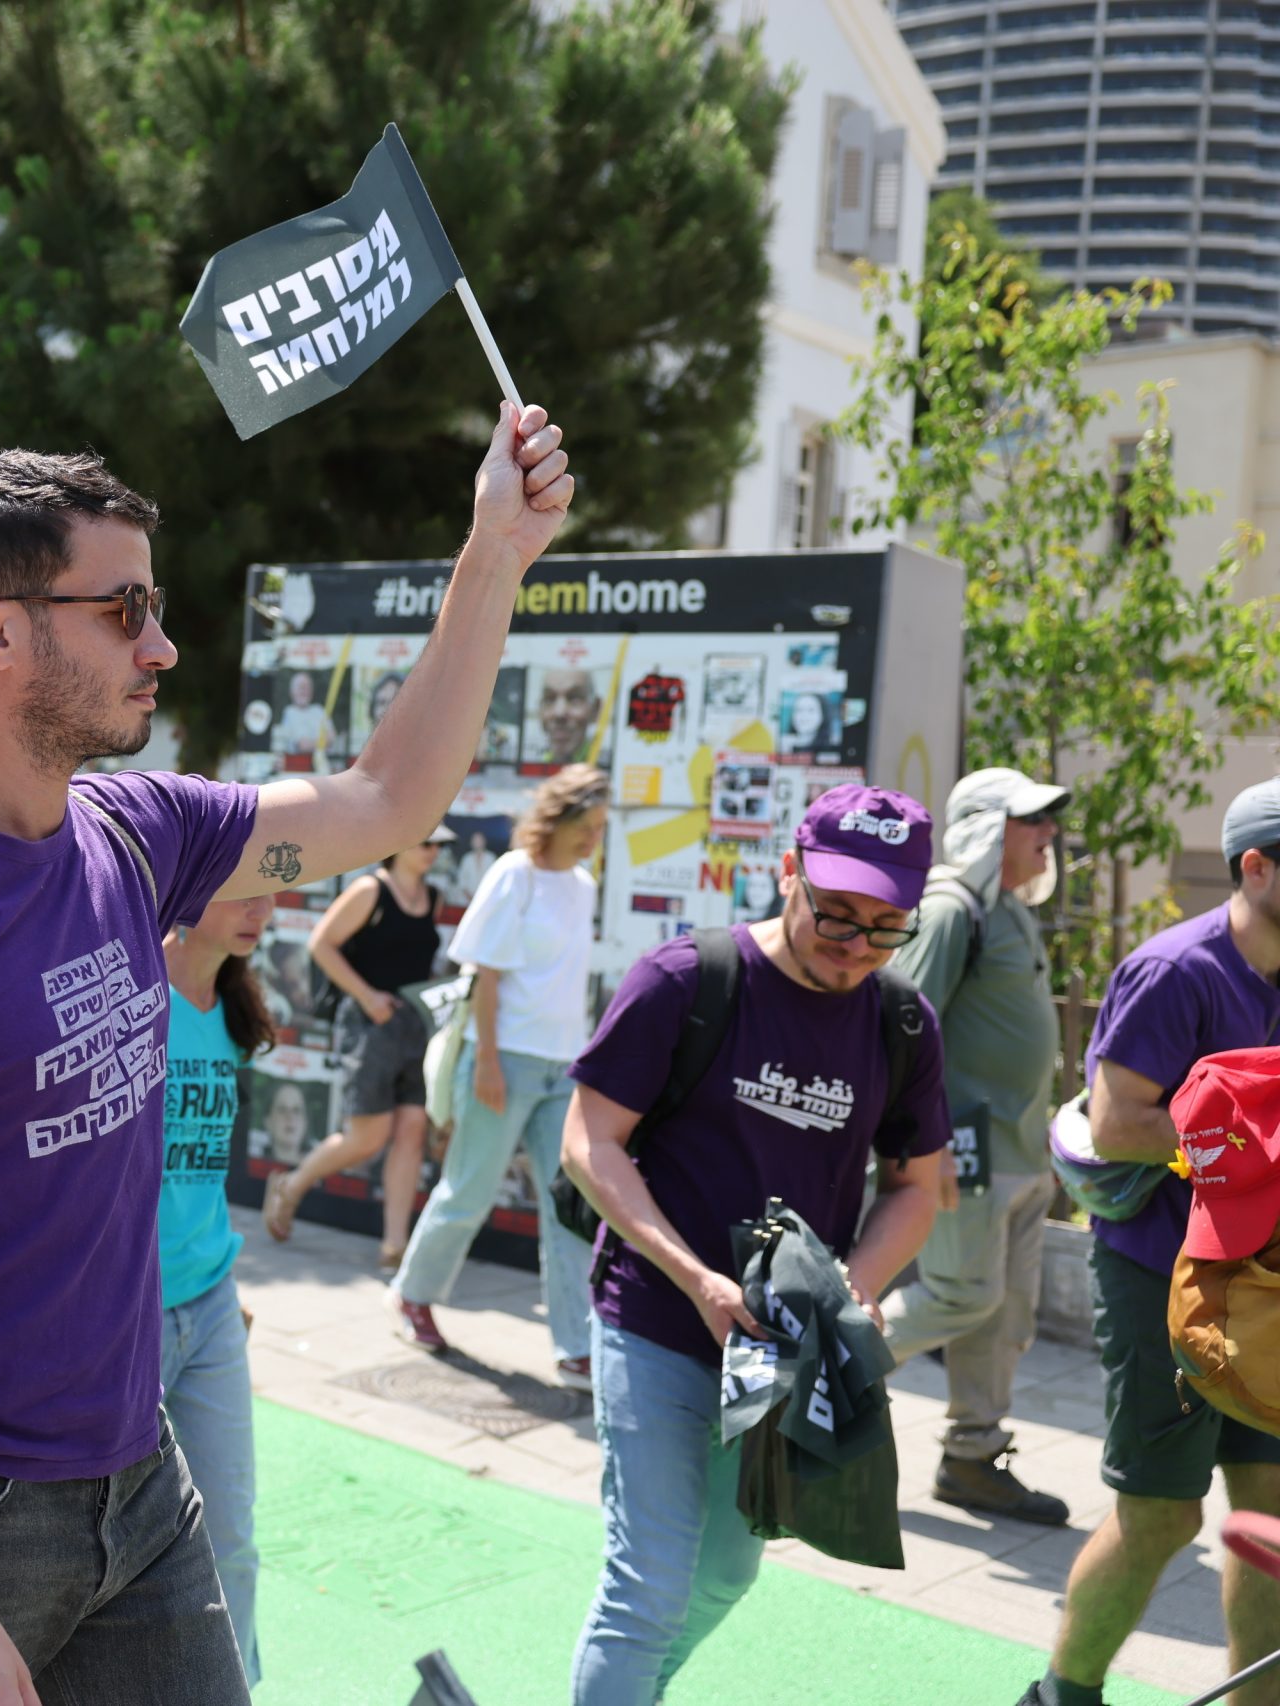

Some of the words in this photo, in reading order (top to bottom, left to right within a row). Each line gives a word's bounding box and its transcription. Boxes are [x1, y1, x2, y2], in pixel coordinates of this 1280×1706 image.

[222, 208, 401, 346] מסרבים
[249, 257, 412, 395] למלחמה
[47, 961, 96, 996] איפה
[61, 992, 104, 1028] שיש
[44, 1023, 114, 1088] מאבק
[96, 1062, 117, 1089] יש
[732, 1077, 778, 1103] ביחד
[179, 1083, 235, 1118] RUN
[779, 1090, 853, 1120] עומדים
